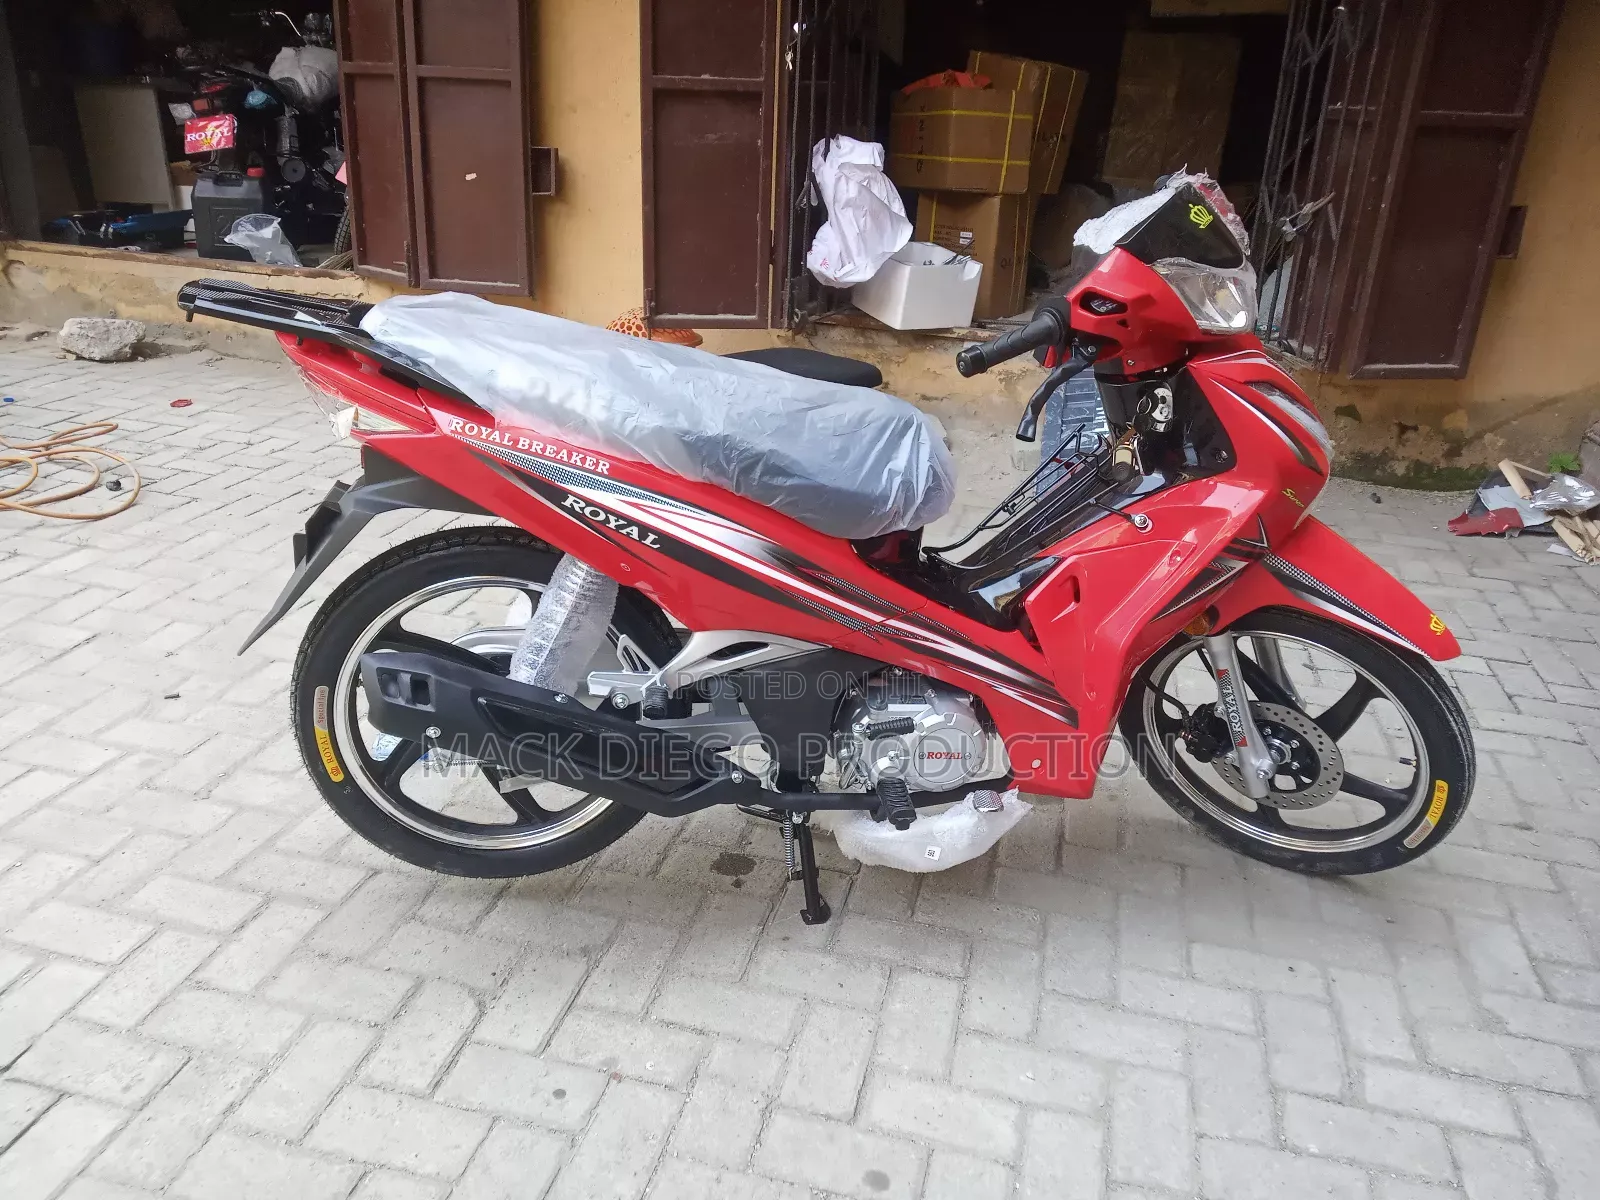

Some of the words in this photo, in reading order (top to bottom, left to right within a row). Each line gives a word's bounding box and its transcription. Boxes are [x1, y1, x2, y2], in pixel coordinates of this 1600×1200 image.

[186, 128, 231, 142] ROYAL
[449, 417, 513, 446] ROYAL
[518, 438, 610, 475] BREAKER
[561, 493, 661, 549] ROYAL
[1223, 685, 1243, 733] ROYAL
[320, 734, 334, 764] ROYAL
[926, 751, 963, 760] ROYAL
[1429, 796, 1444, 819] ROYAL
